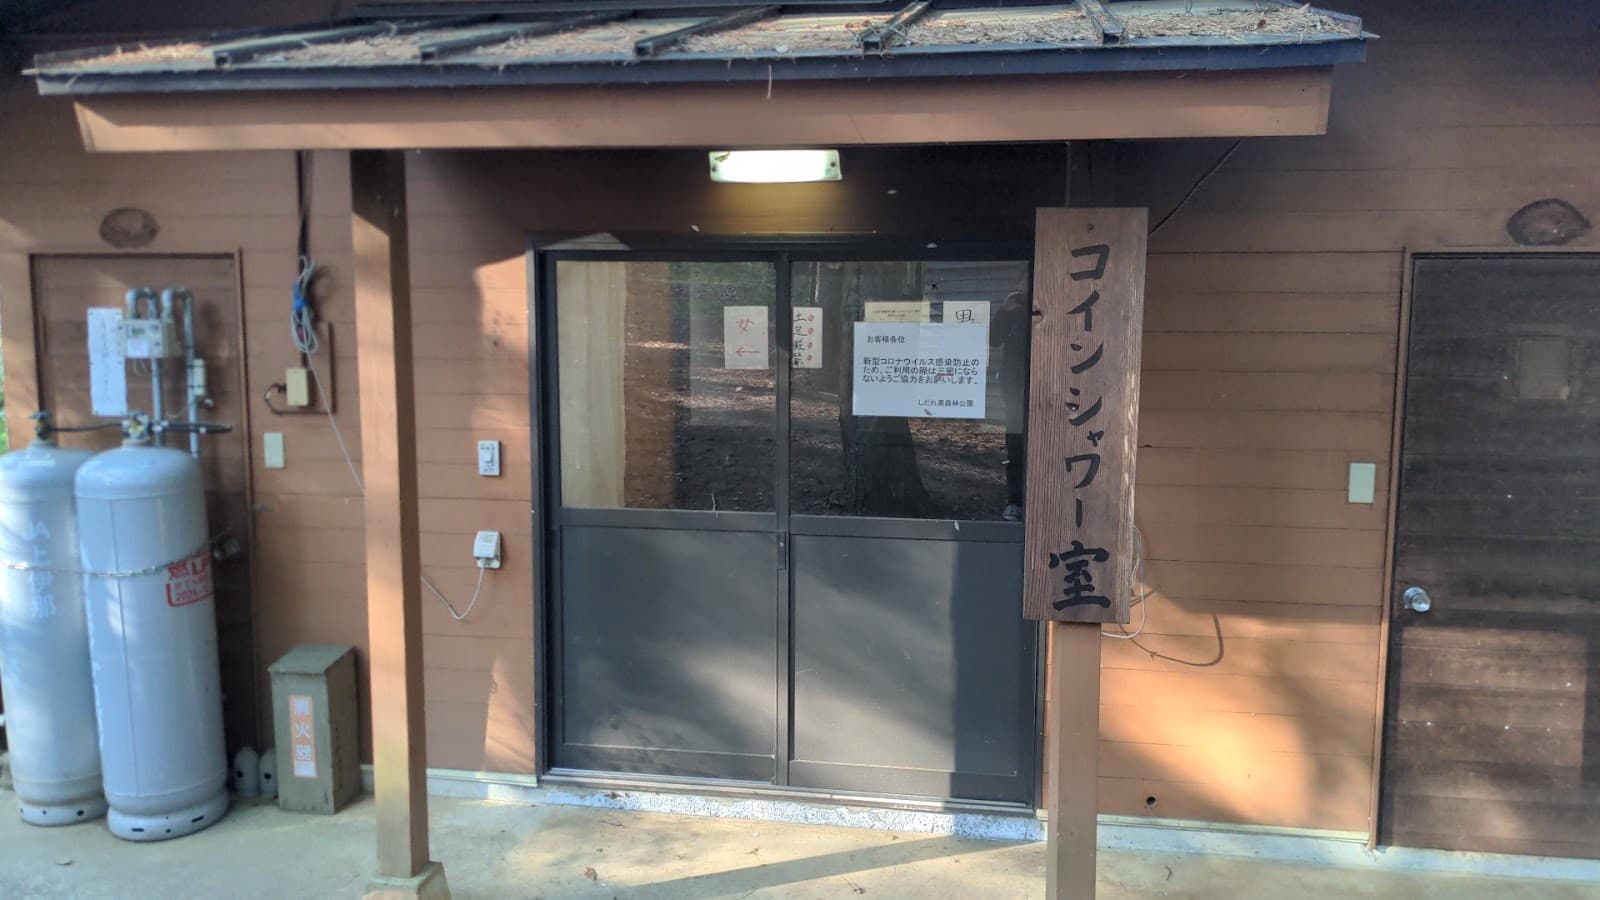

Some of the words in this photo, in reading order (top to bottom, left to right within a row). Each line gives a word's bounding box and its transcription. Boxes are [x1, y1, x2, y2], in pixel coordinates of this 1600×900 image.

[737, 318, 754, 333] 女
[866, 335, 905, 344] お客様各位
[863, 357, 980, 366] 新型コロナウイルス感染防止の
[863, 375, 979, 385] ないようご協力をお願いします。
[1048, 243, 1112, 611] コインシャワー室
